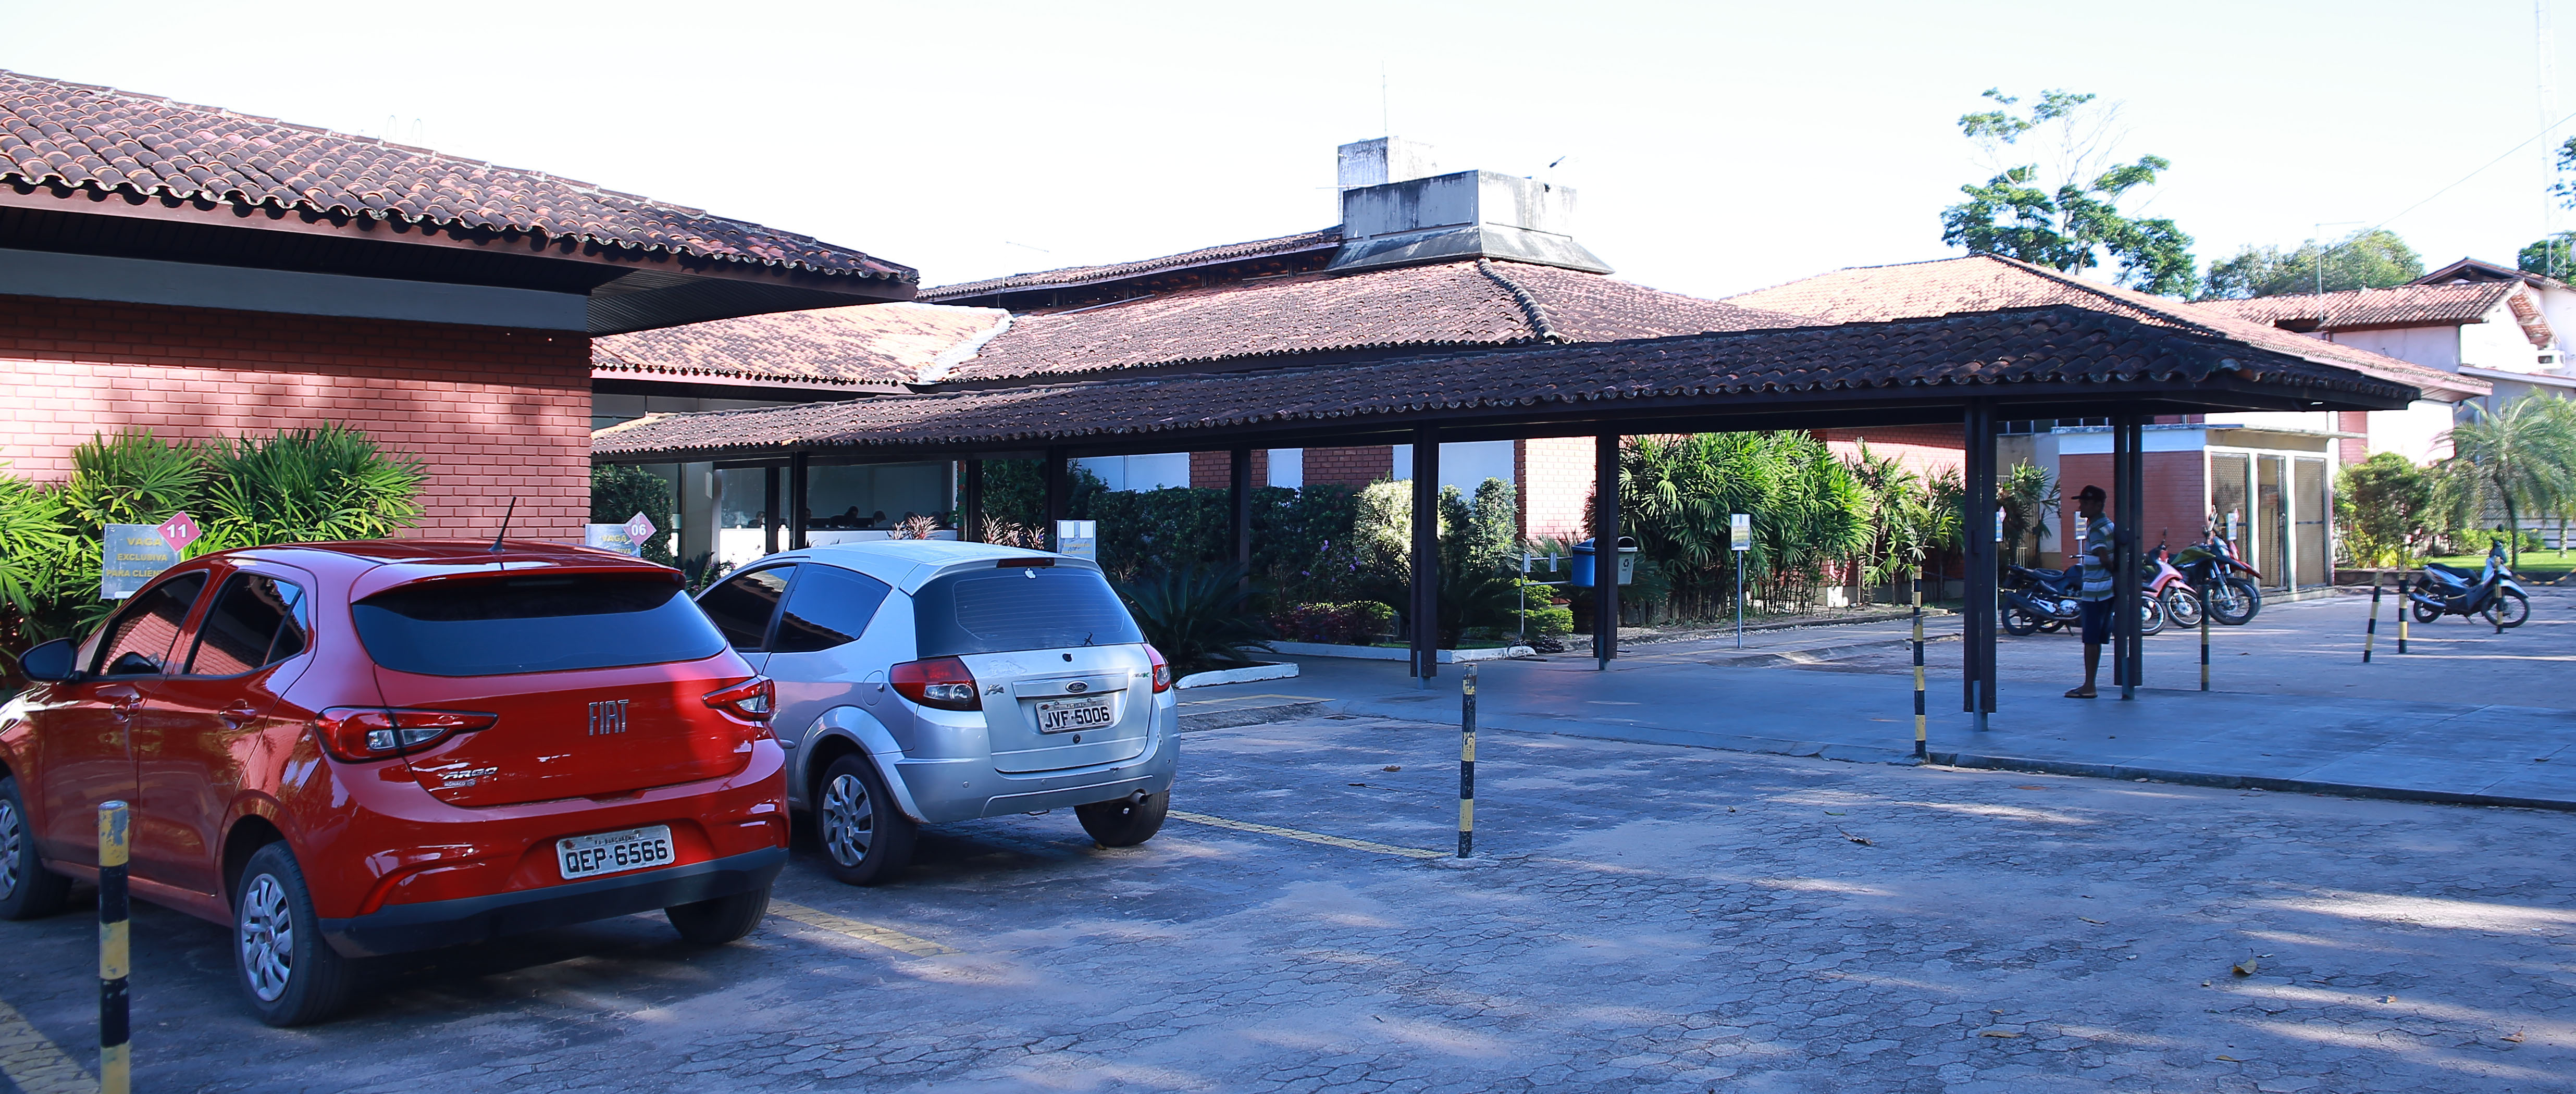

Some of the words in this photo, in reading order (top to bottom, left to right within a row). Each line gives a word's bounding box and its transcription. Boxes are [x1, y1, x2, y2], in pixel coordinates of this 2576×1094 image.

[166, 524, 187, 538] 11
[631, 524, 647, 537] 06
[127, 538, 162, 546] VAGA
[589, 699, 629, 736] FIAT
[442, 766, 498, 780] ARGO
